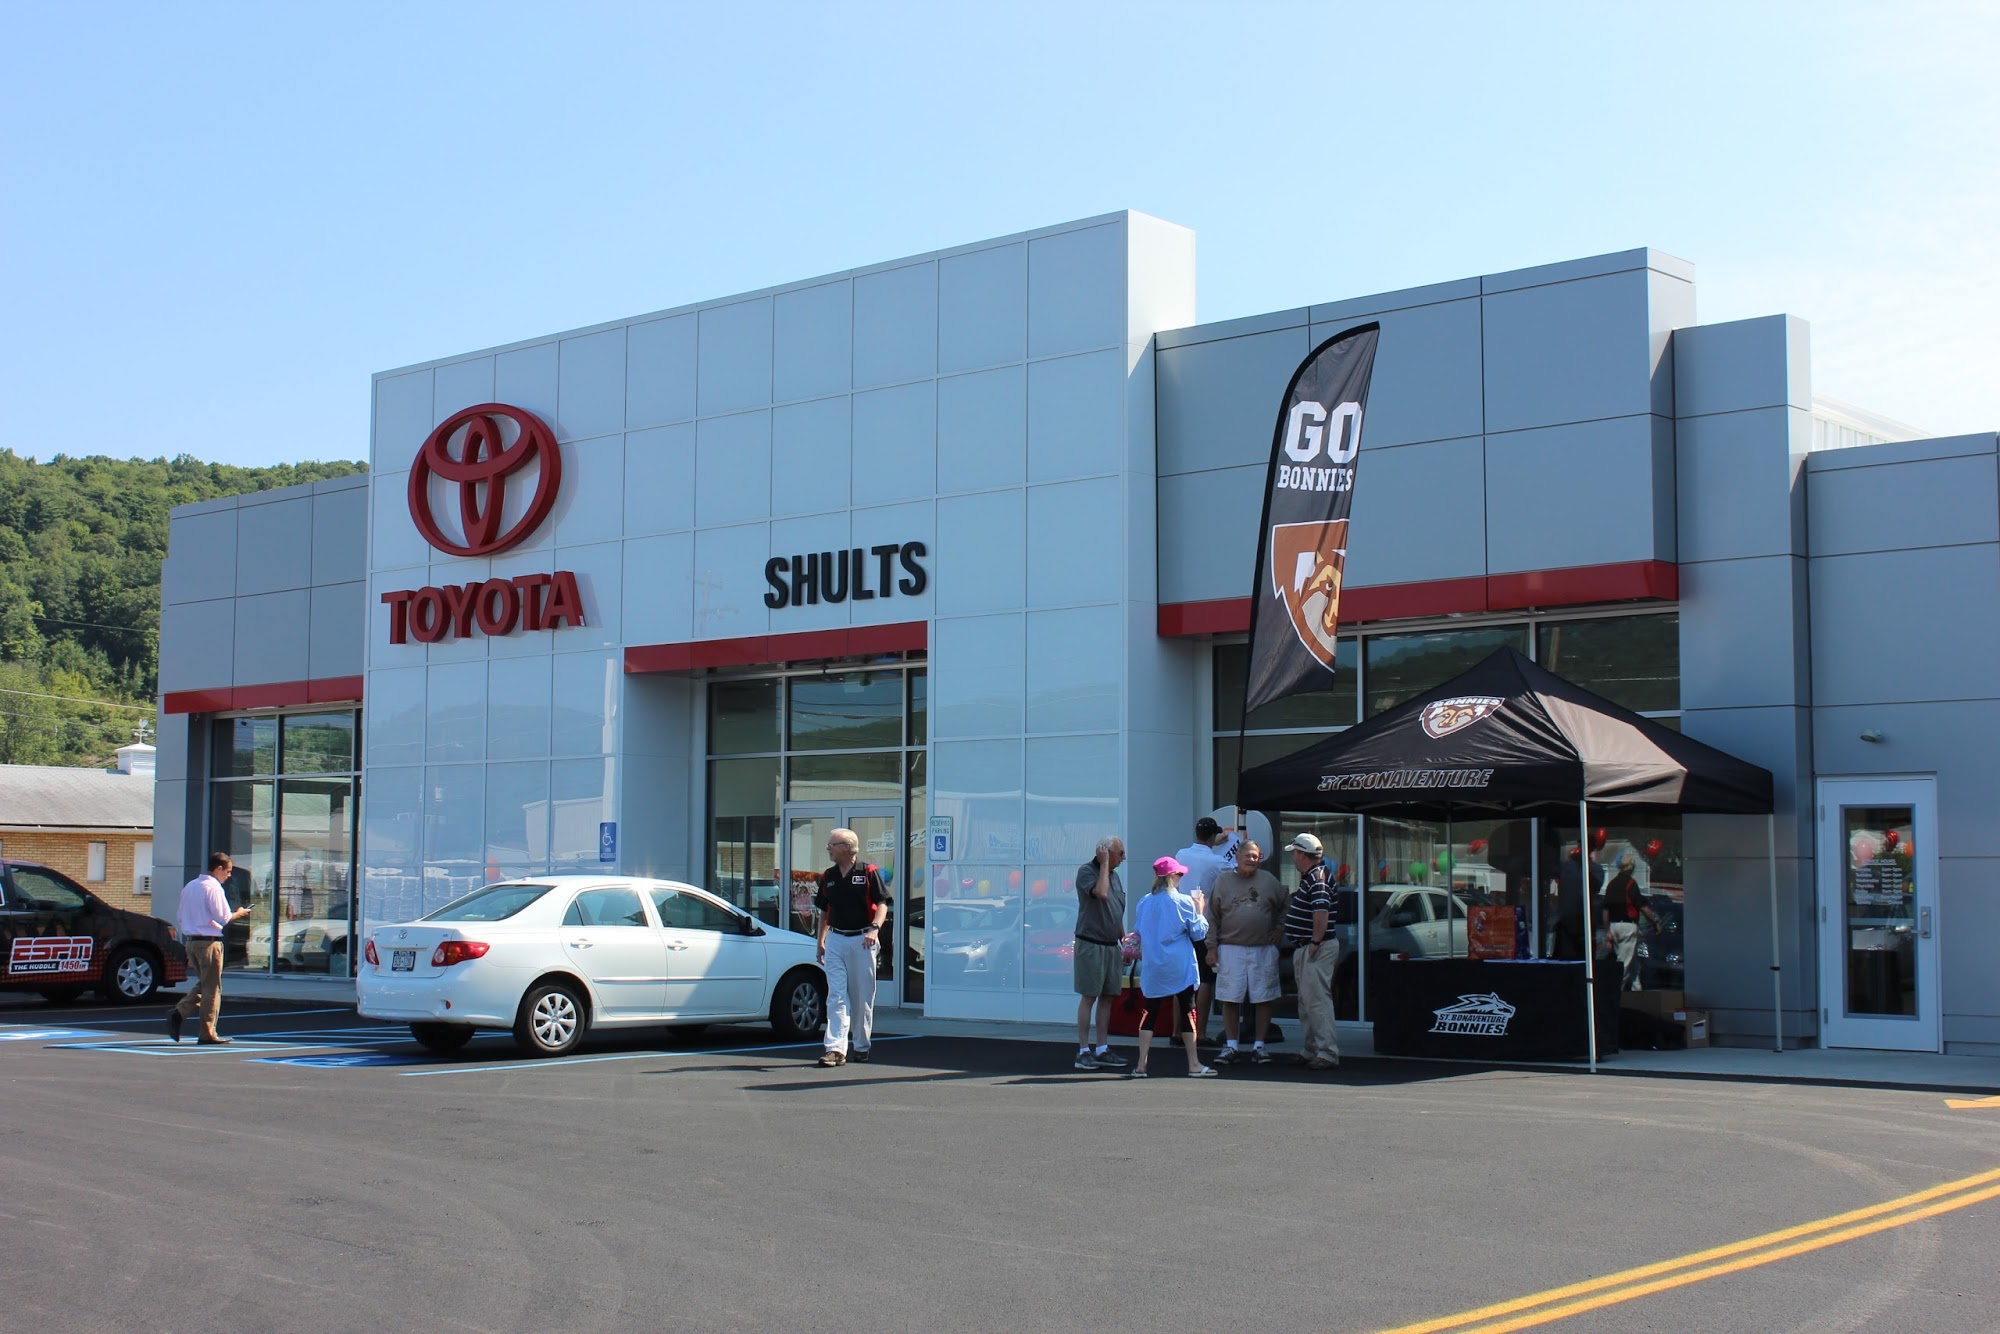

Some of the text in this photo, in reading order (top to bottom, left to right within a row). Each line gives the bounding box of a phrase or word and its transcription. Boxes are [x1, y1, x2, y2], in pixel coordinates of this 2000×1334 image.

[1284, 400, 1363, 464] GO
[1277, 464, 1353, 492] BONNIES
[763, 541, 927, 609] SHULTS
[381, 571, 586, 645] TOYOTA
[1431, 697, 1501, 709] BONNIES
[1348, 768, 1494, 790] BONAVENTURE
[12, 937, 93, 961] ESPN
[1435, 1021, 1505, 1034] BONNIES
[1451, 1014, 1506, 1023] BONAVENTURE
